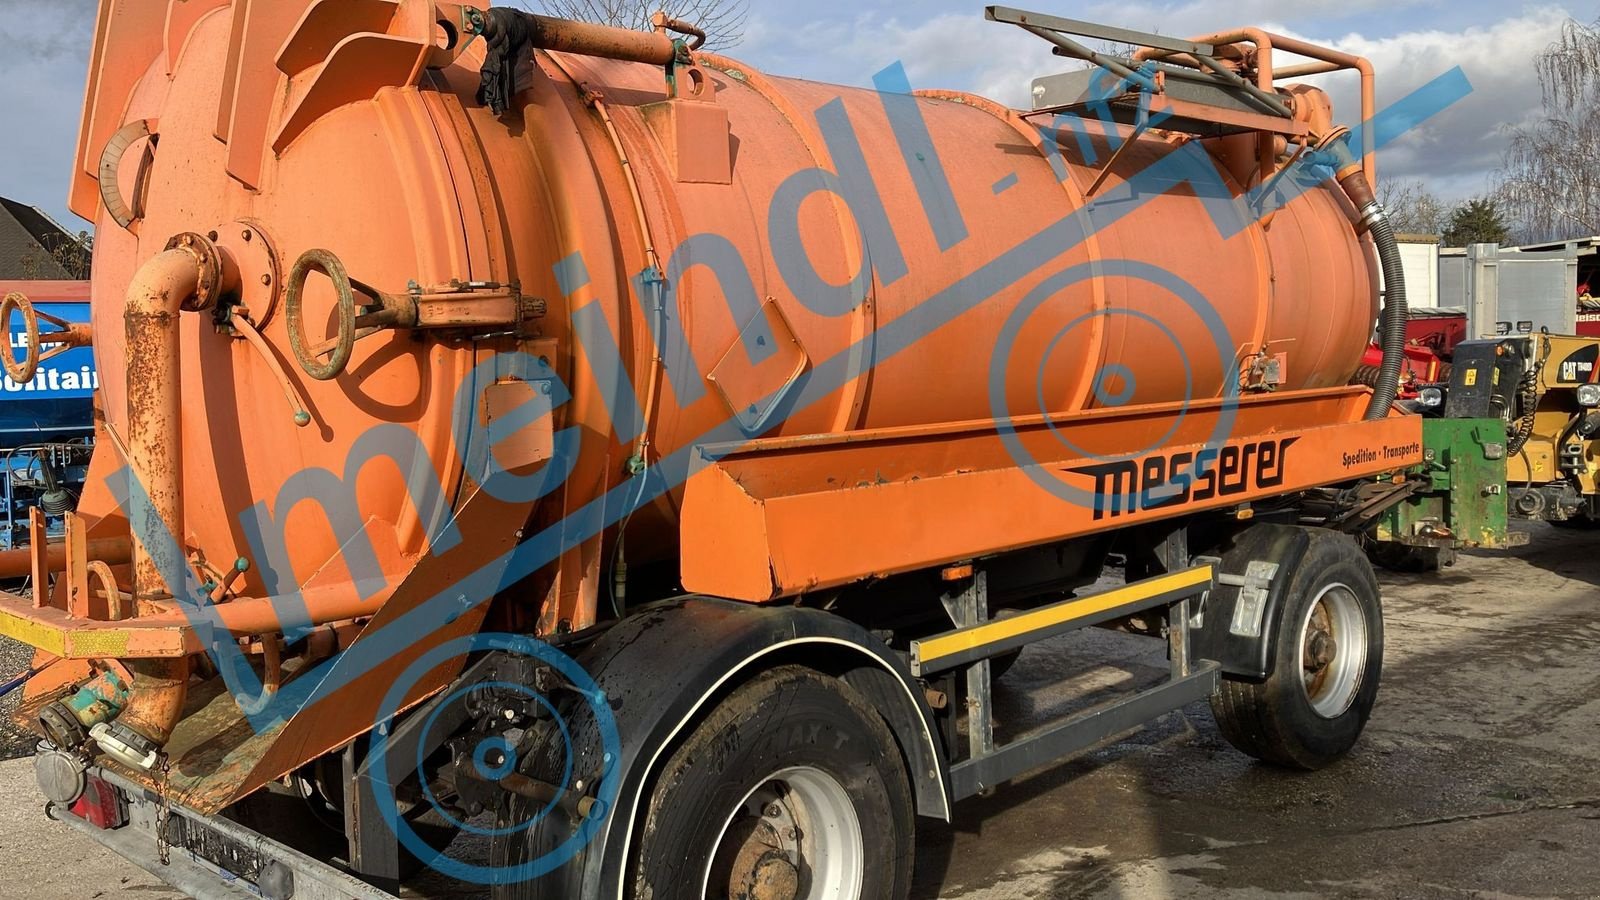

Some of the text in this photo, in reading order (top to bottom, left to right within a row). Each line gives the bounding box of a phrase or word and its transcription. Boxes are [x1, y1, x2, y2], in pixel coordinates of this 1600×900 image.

[1563, 361, 1577, 380] CAT
[1342, 442, 1420, 469] Spedition Transporte
[1059, 436, 1302, 521] messerer
